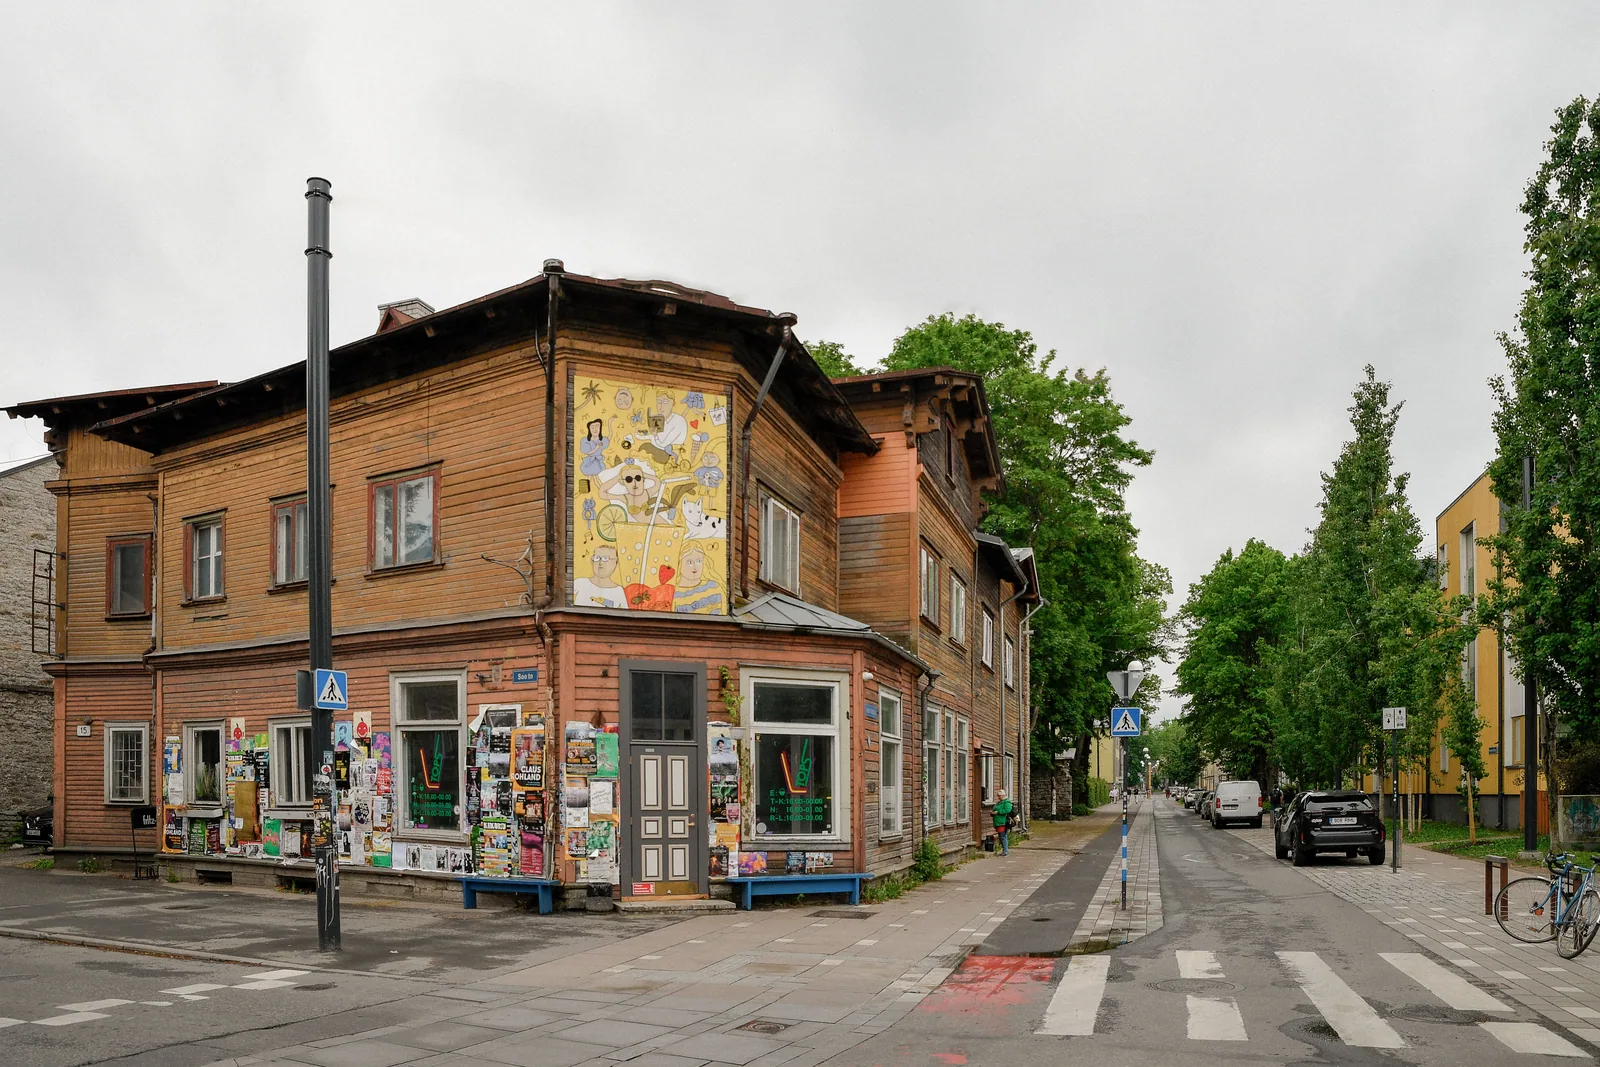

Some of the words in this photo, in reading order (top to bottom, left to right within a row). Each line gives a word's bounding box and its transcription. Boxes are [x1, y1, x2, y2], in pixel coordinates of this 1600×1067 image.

[517, 673, 527, 681] Soo
[80, 726, 88, 735] 15
[520, 765, 542, 773] CLAUS
